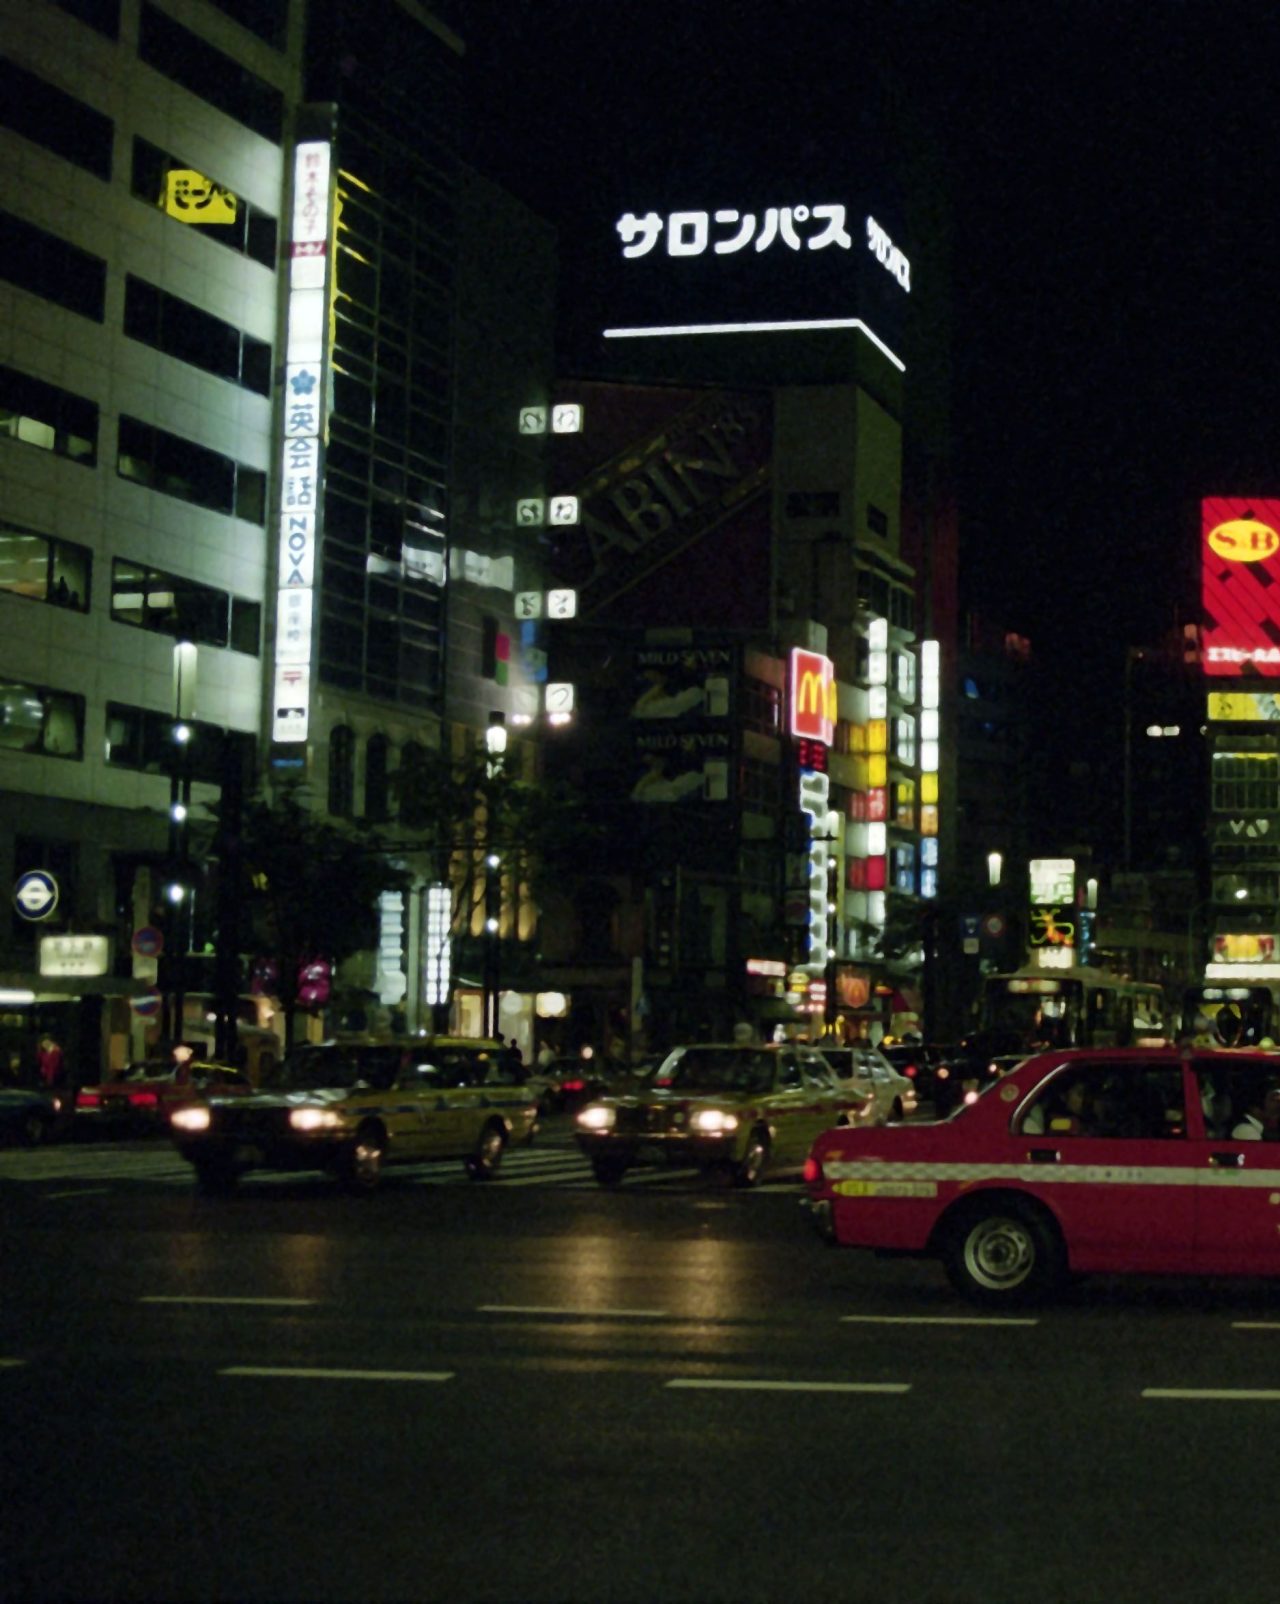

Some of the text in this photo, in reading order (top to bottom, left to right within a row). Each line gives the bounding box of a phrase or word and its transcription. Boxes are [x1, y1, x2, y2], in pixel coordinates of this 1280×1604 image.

[615, 203, 853, 259] サロンパス
[287, 516, 307, 585] NOVA
